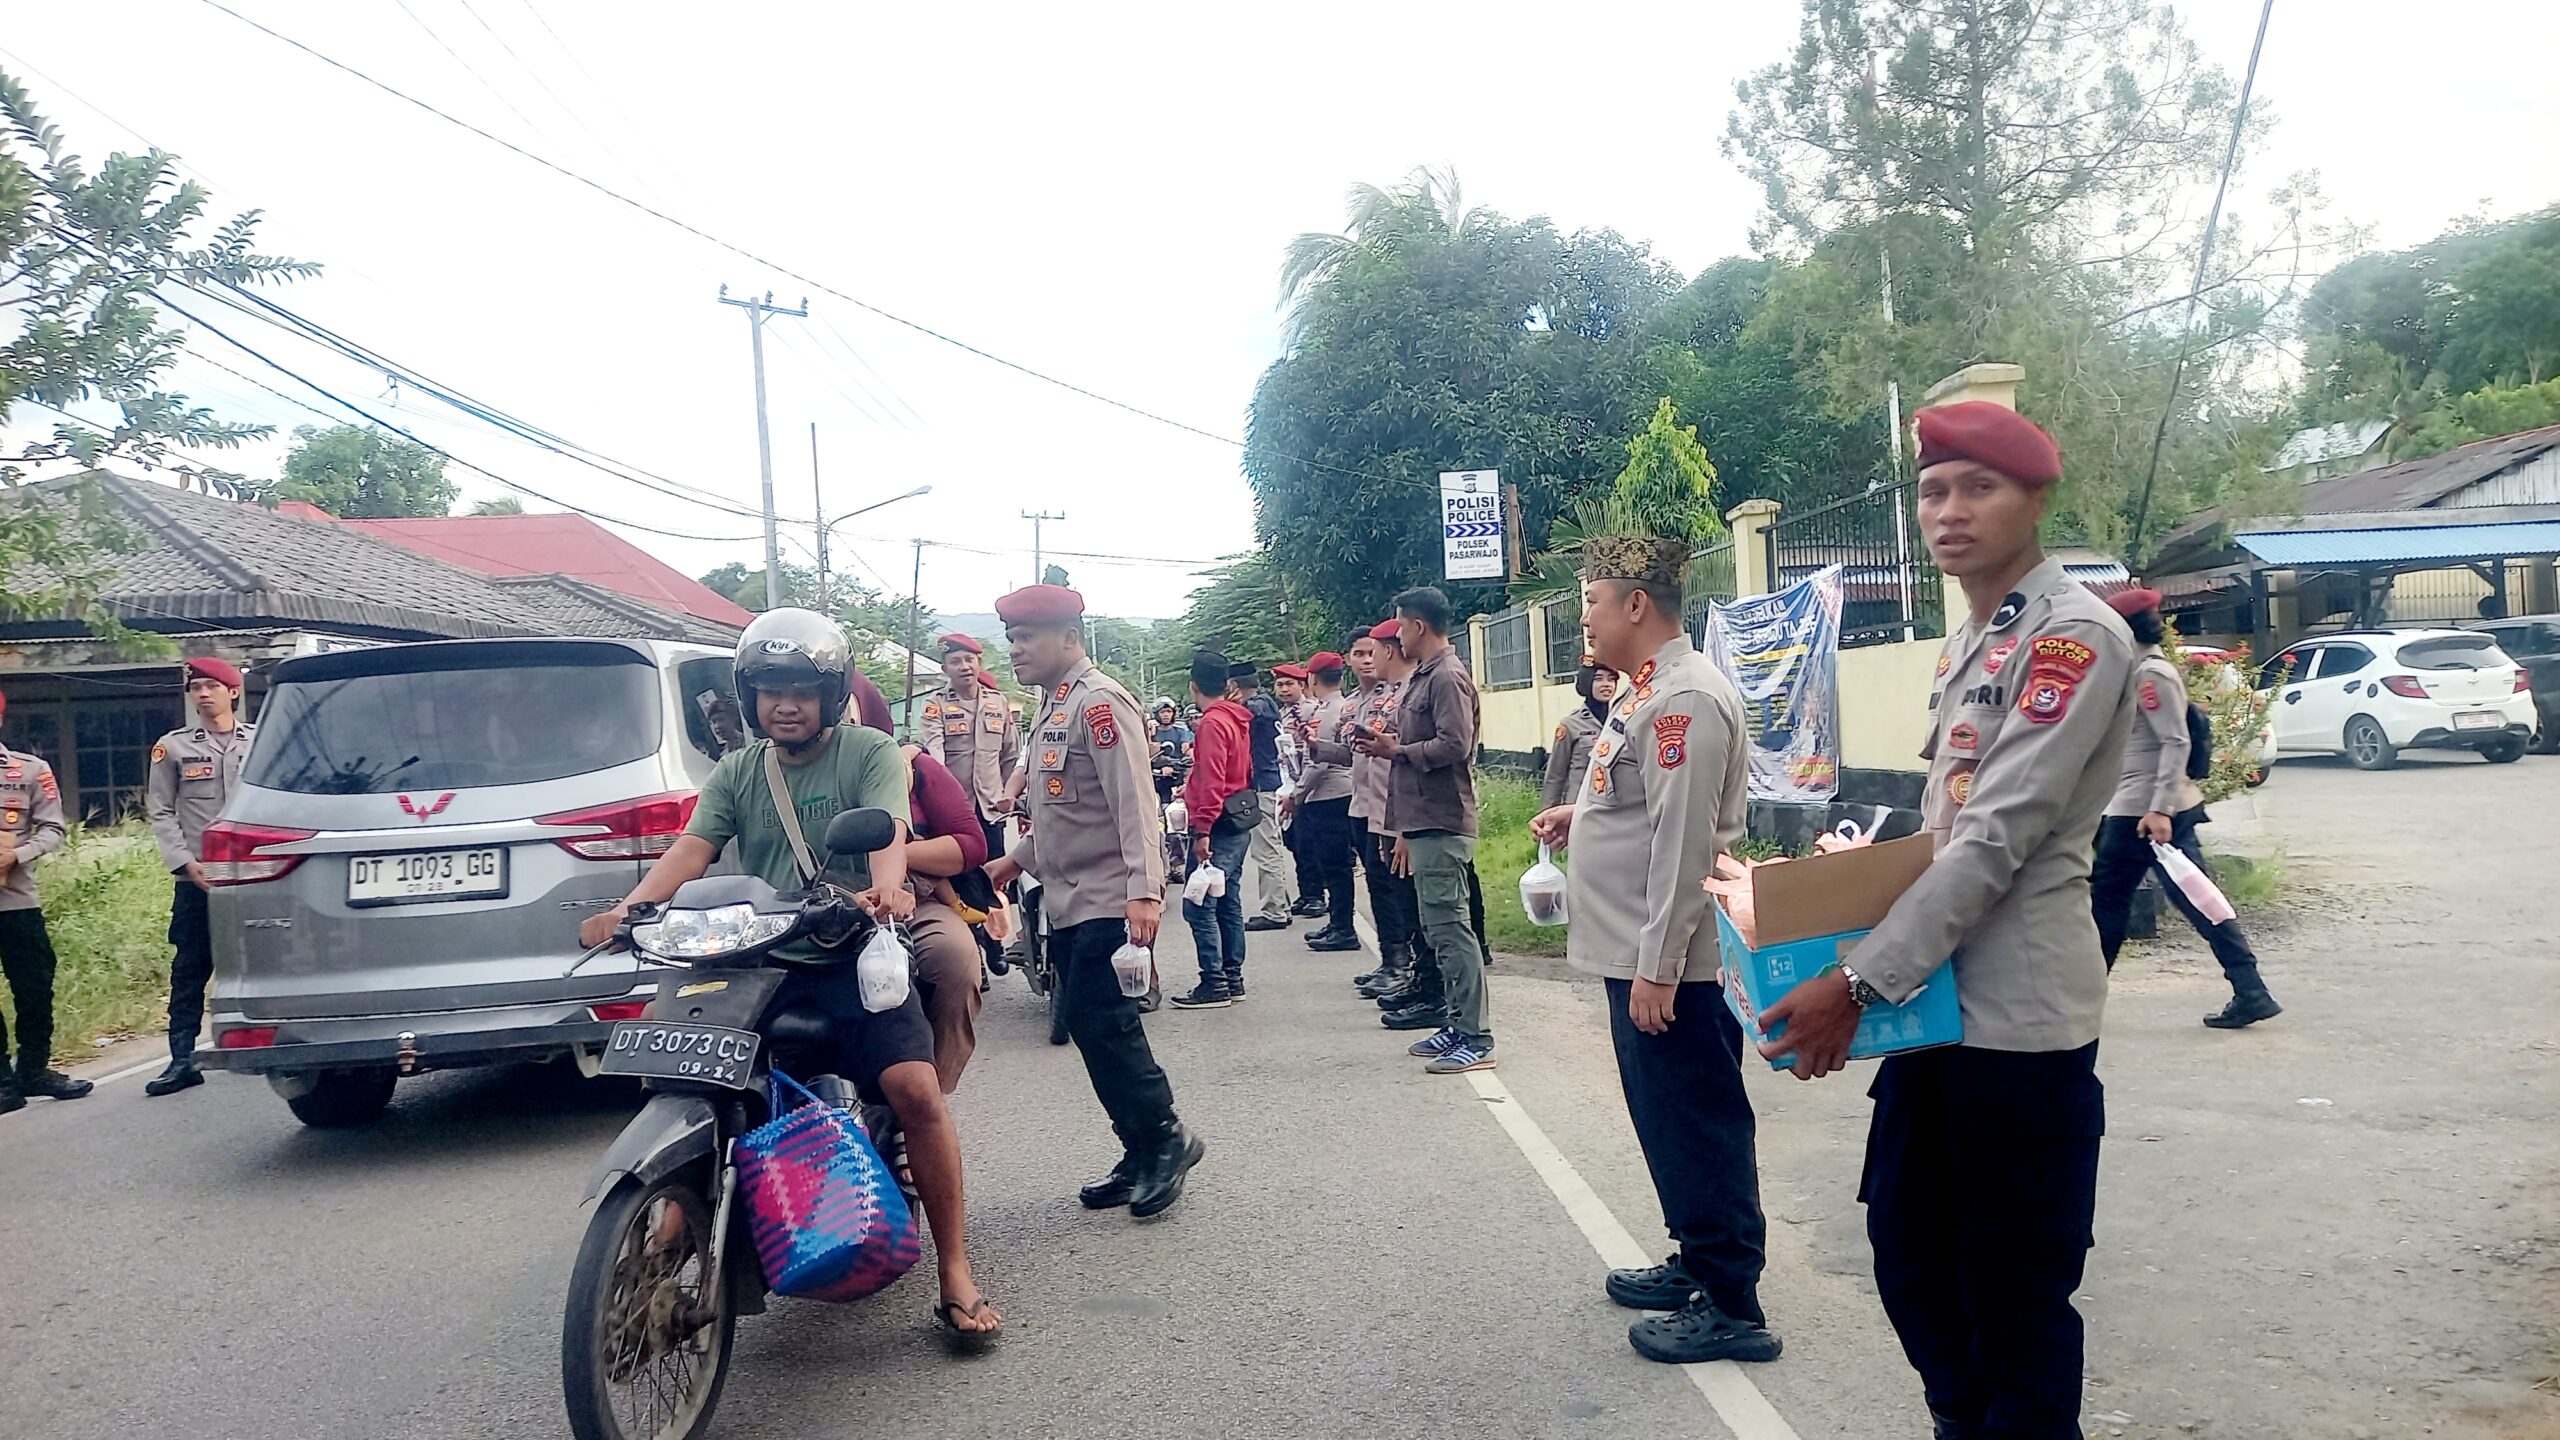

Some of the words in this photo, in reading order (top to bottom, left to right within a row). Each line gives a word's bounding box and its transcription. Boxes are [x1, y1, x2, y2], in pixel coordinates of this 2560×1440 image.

[1447, 496, 1494, 510] POLISI
[1447, 510, 1496, 523] POLICE
[1457, 539, 1489, 549] POLSEK
[1449, 549, 1498, 560] PASARWAJO
[2035, 639, 2091, 659] POLRES
[2040, 647, 2085, 664] BUTON
[1042, 731, 1067, 743] POLRI
[354, 860, 383, 885] DT
[397, 855, 452, 881] 1093
[467, 852, 495, 876] GG
[1778, 960, 1793, 972] 12
[614, 1029, 649, 1052] DT
[650, 1029, 714, 1056] 3073
[717, 1035, 751, 1063] CC
